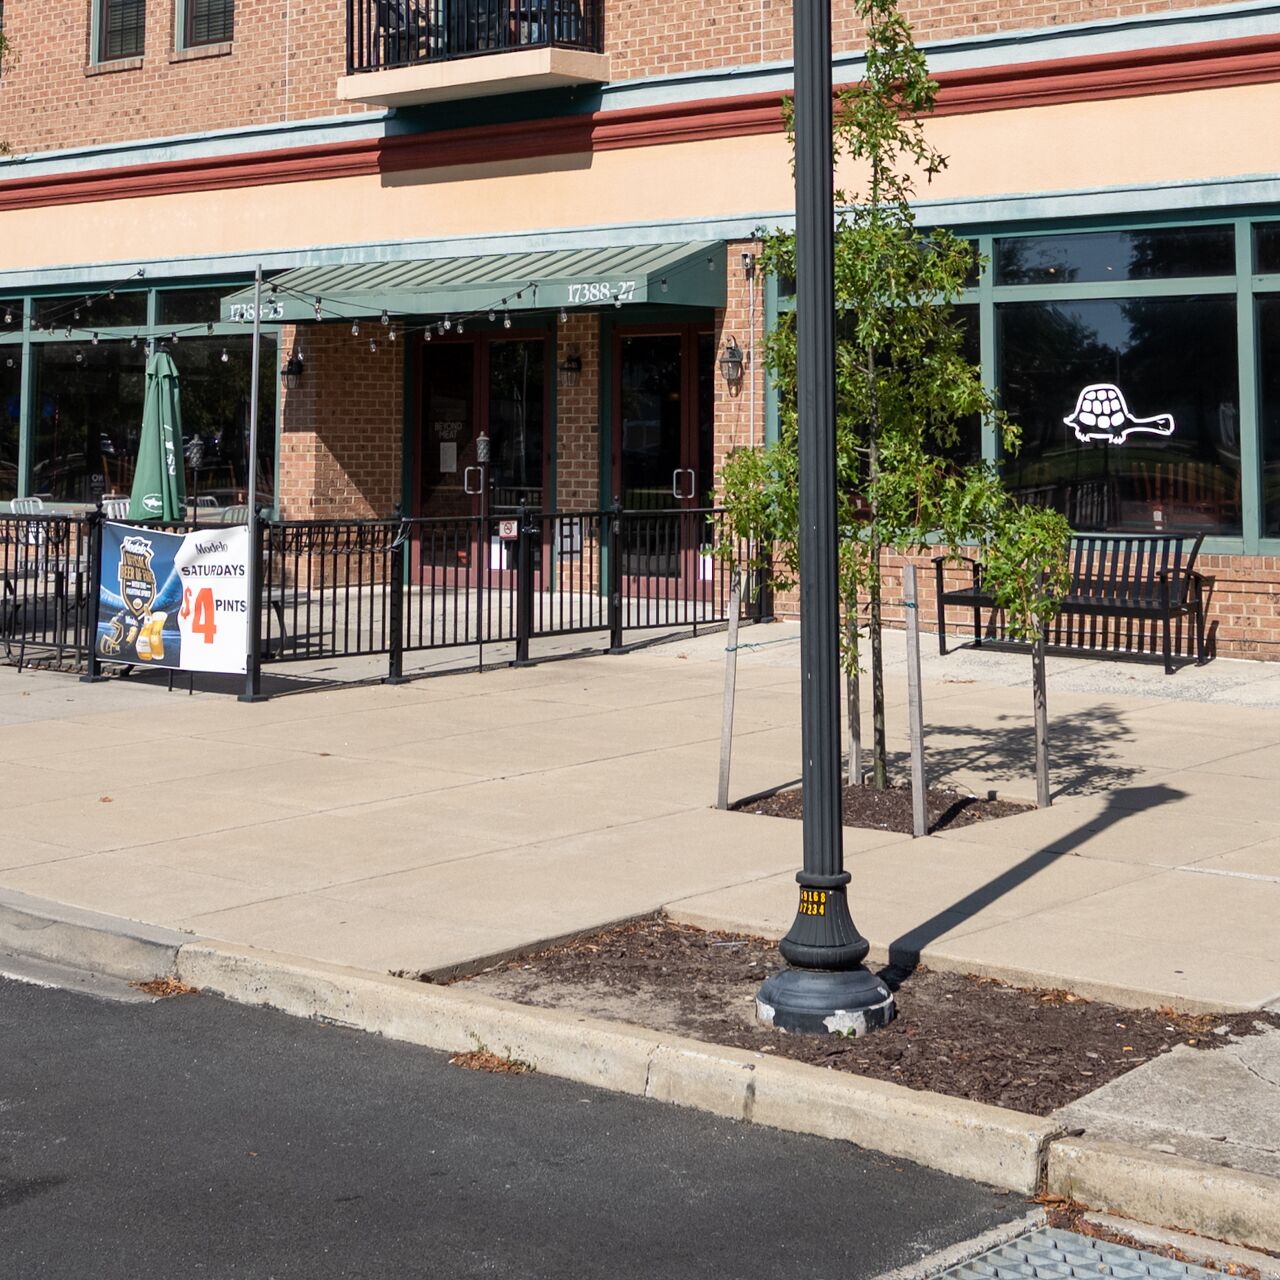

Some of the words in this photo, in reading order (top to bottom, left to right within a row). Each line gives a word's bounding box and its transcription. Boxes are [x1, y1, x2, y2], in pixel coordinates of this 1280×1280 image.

[567, 281, 635, 302] 17388-27
[195, 542, 228, 555] Modelo
[182, 564, 245, 576] SATURDAYS
[180, 586, 217, 644] $4
[215, 599, 247, 613] PINTS
